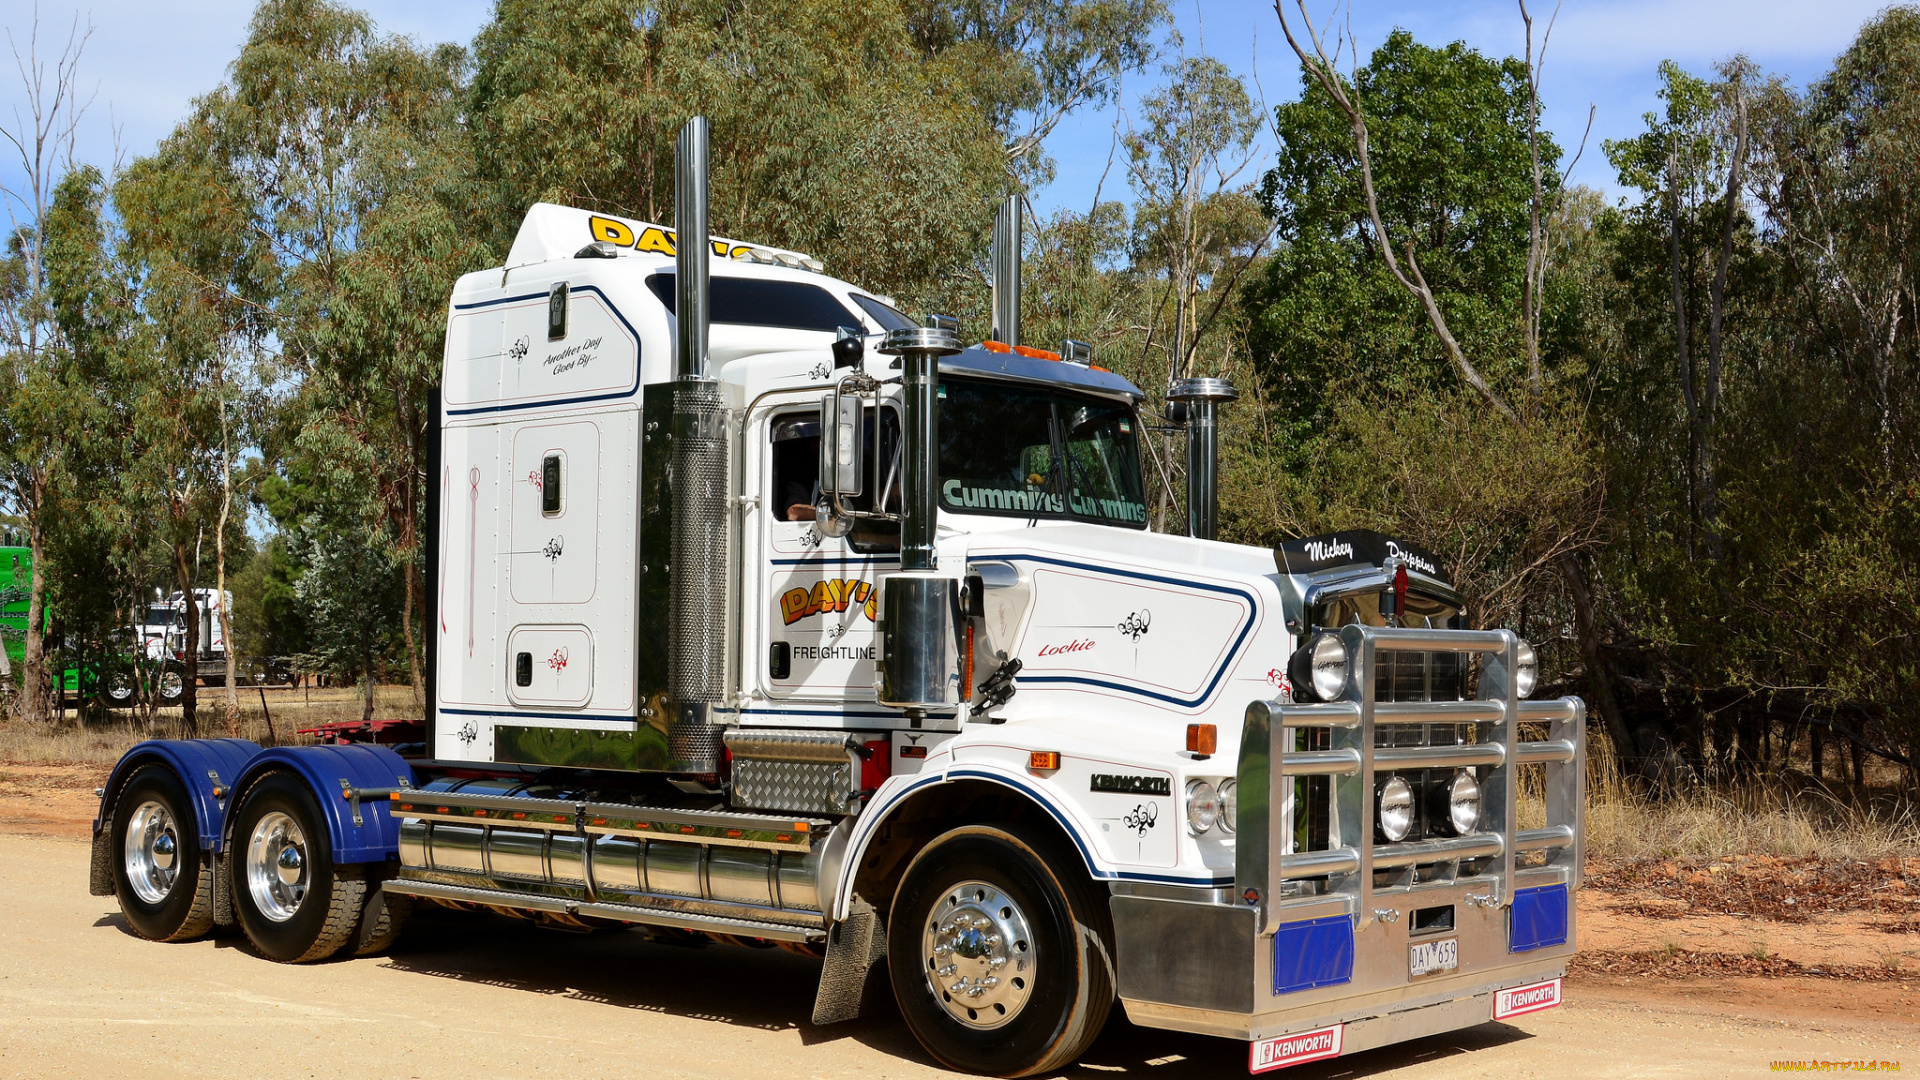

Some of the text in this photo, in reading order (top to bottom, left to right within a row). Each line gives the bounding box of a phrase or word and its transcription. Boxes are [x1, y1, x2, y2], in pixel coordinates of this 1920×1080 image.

[589, 215, 756, 261] DA'
[543, 336, 603, 367] Another Day
[553, 361, 576, 376] Goes
[943, 479, 1064, 513] Cummins
[1068, 488, 1146, 522] Cummins
[1304, 537, 1436, 575] Mickey Drippins
[1038, 638, 1096, 657] Lochie
[1090, 773, 1171, 794] KENWORTH
[1412, 946, 1430, 969] DAY
[1438, 941, 1456, 964] 659
[1511, 985, 1554, 1008] KENWORTH
[1274, 1033, 1332, 1059] KENWORTH
